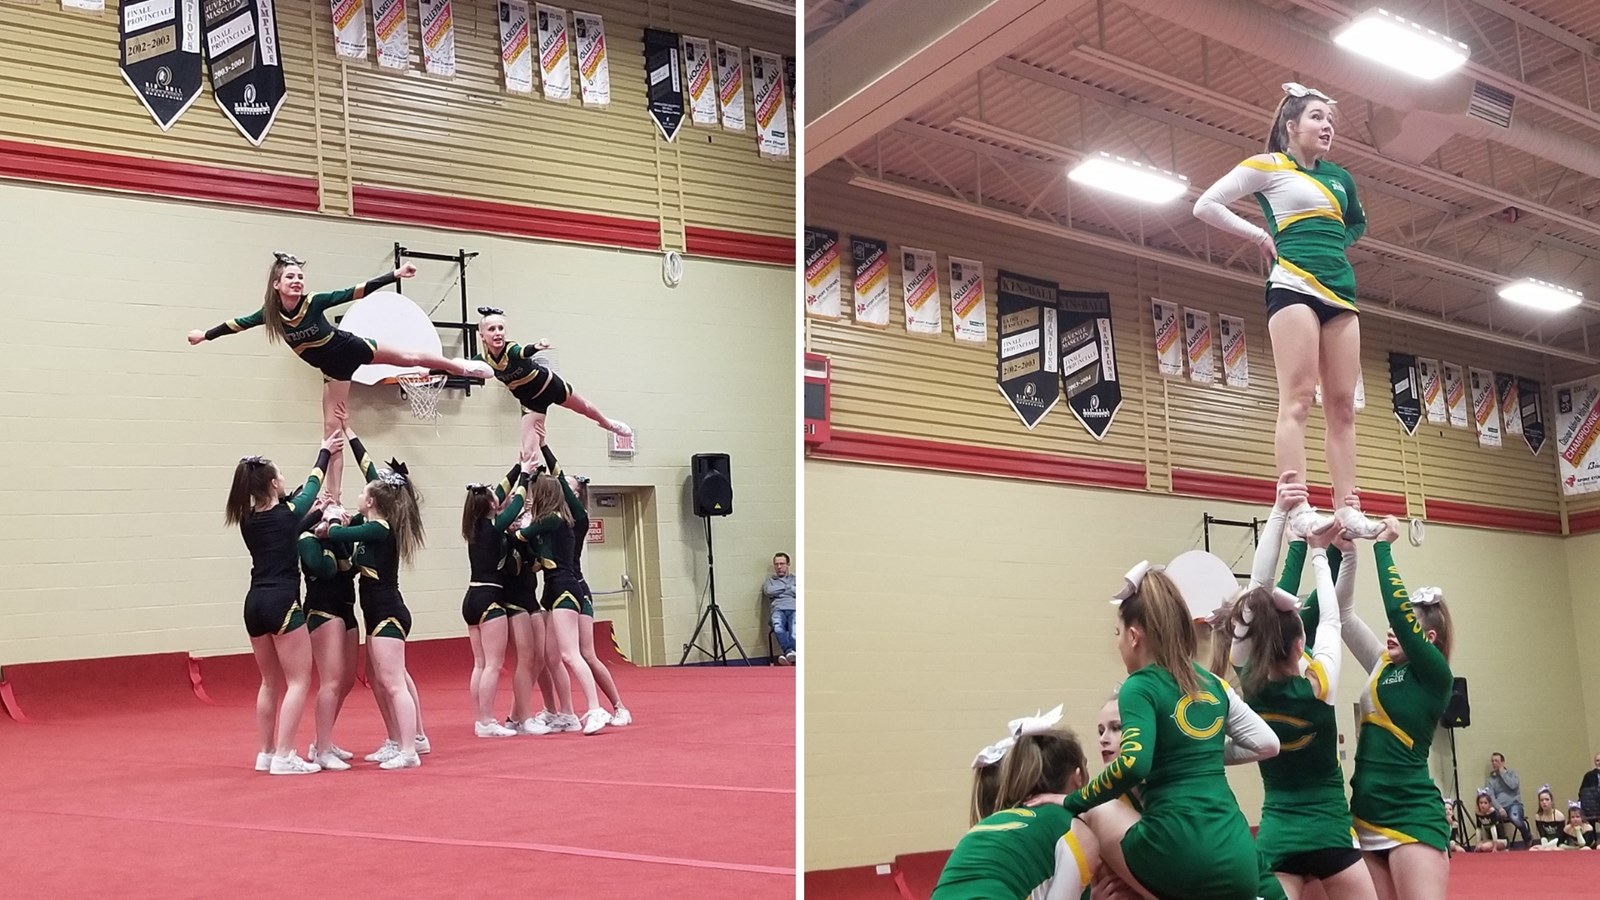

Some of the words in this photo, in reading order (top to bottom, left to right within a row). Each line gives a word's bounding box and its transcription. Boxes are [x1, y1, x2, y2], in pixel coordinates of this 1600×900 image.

[127, 6, 151, 18] FINALE
[127, 7, 173, 26] PROVINCIALE
[210, 27, 232, 44] FINALE
[212, 24, 252, 51] PROVINCIALE
[261, 0, 274, 63] AMPIONS
[128, 35, 170, 56] 2002-2003
[214, 57, 245, 79] 2003-2004
[688, 52, 707, 83] HOCKEY
[1156, 314, 1175, 339] HOCKEY
